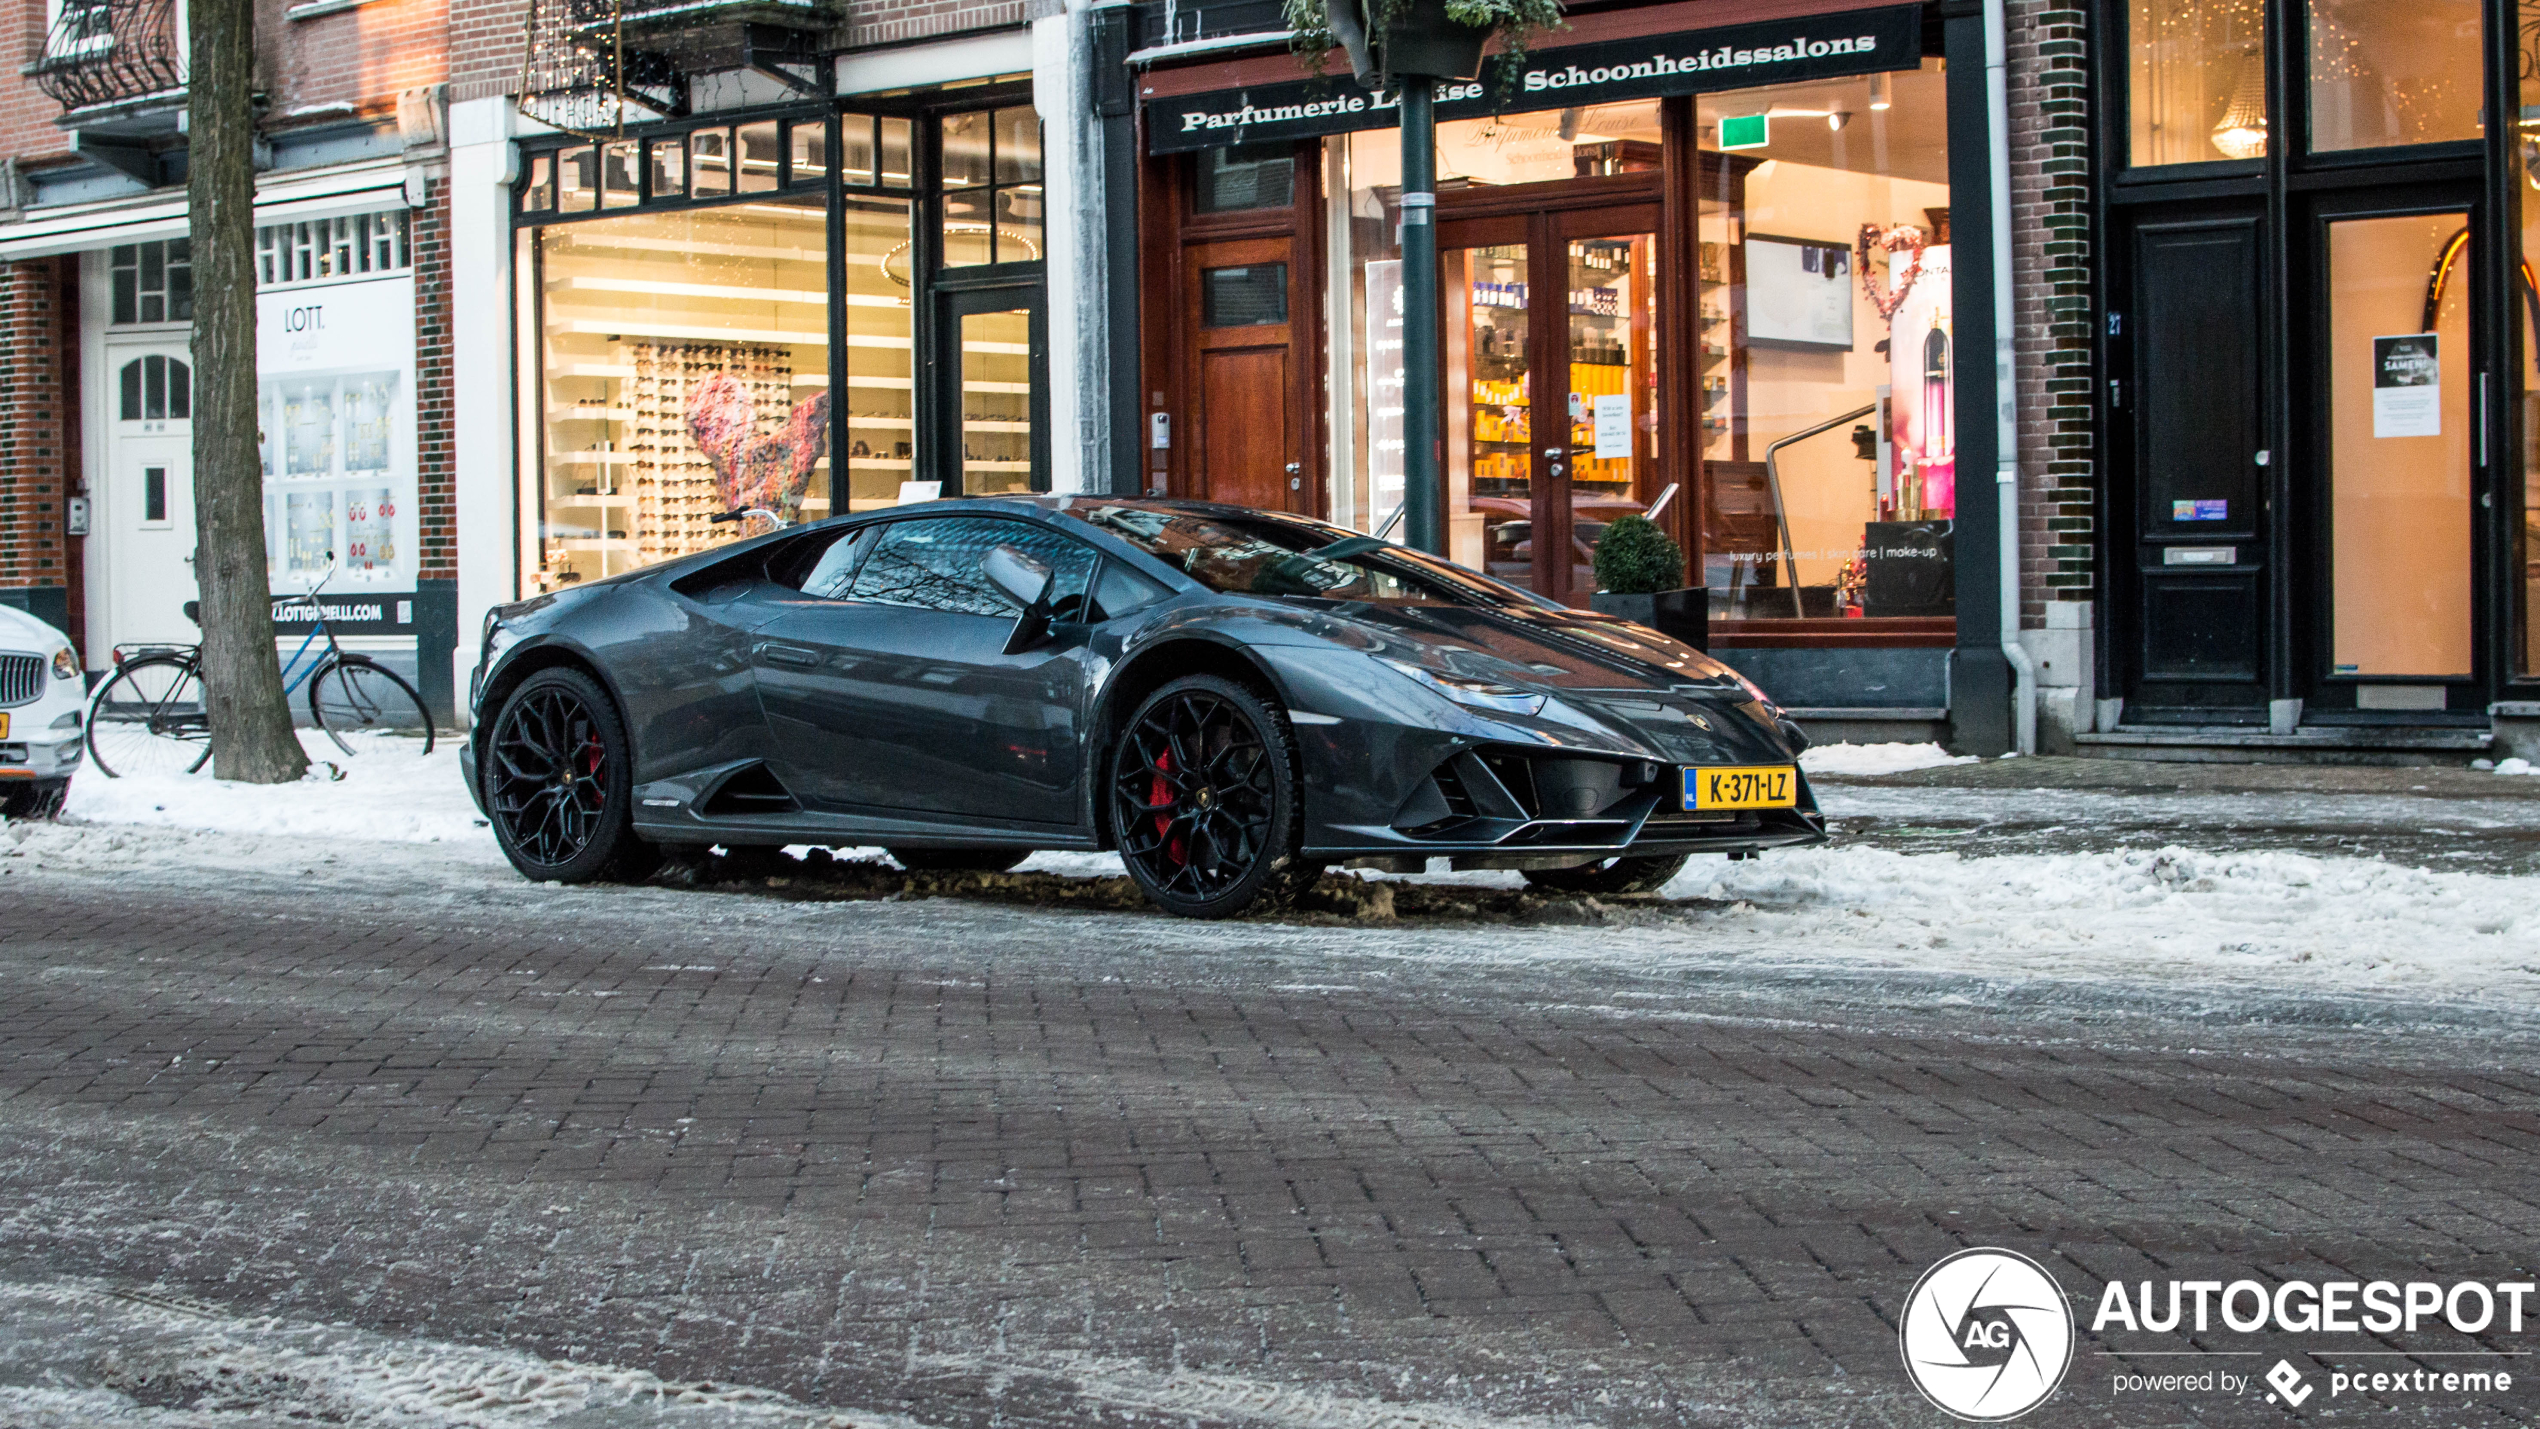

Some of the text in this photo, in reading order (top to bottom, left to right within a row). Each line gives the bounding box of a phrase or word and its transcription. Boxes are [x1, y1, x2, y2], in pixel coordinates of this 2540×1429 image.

[1181, 36, 1876, 132] Parfumerie Lise Schoonheidssalons
[285, 306, 325, 332] LOTT.
[2108, 313, 2121, 335] 27
[1730, 546, 1937, 563] luxury perfumes skin care make-up
[1685, 793, 1695, 802] NL
[1710, 773, 1787, 803] K-371-LZ
